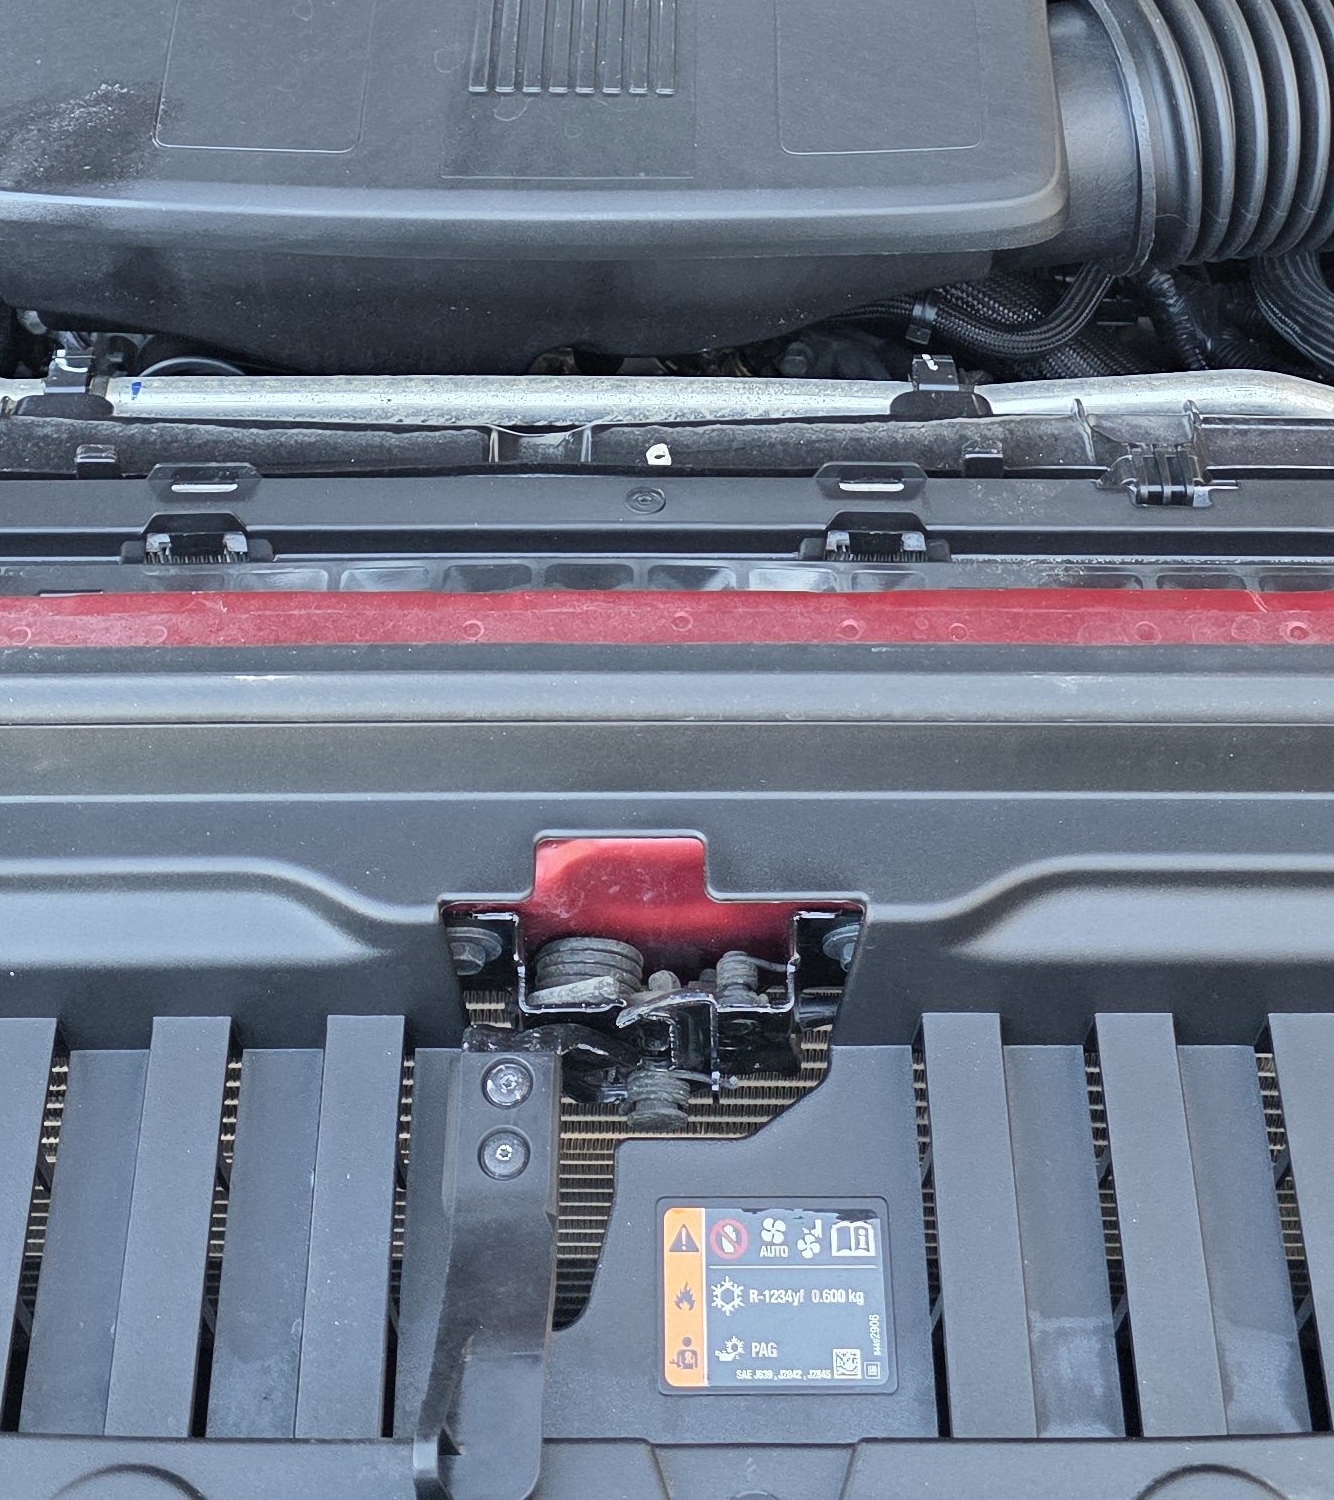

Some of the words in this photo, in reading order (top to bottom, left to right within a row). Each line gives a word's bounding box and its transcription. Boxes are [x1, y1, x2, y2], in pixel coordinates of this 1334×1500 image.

[759, 1245, 789, 1258] AUTO
[749, 1289, 805, 1306] R-1234yf
[811, 1289, 846, 1304] 0.600
[848, 1289, 865, 1306] kg
[751, 1342, 779, 1358] PAG
[736, 1369, 753, 1380] SAE
